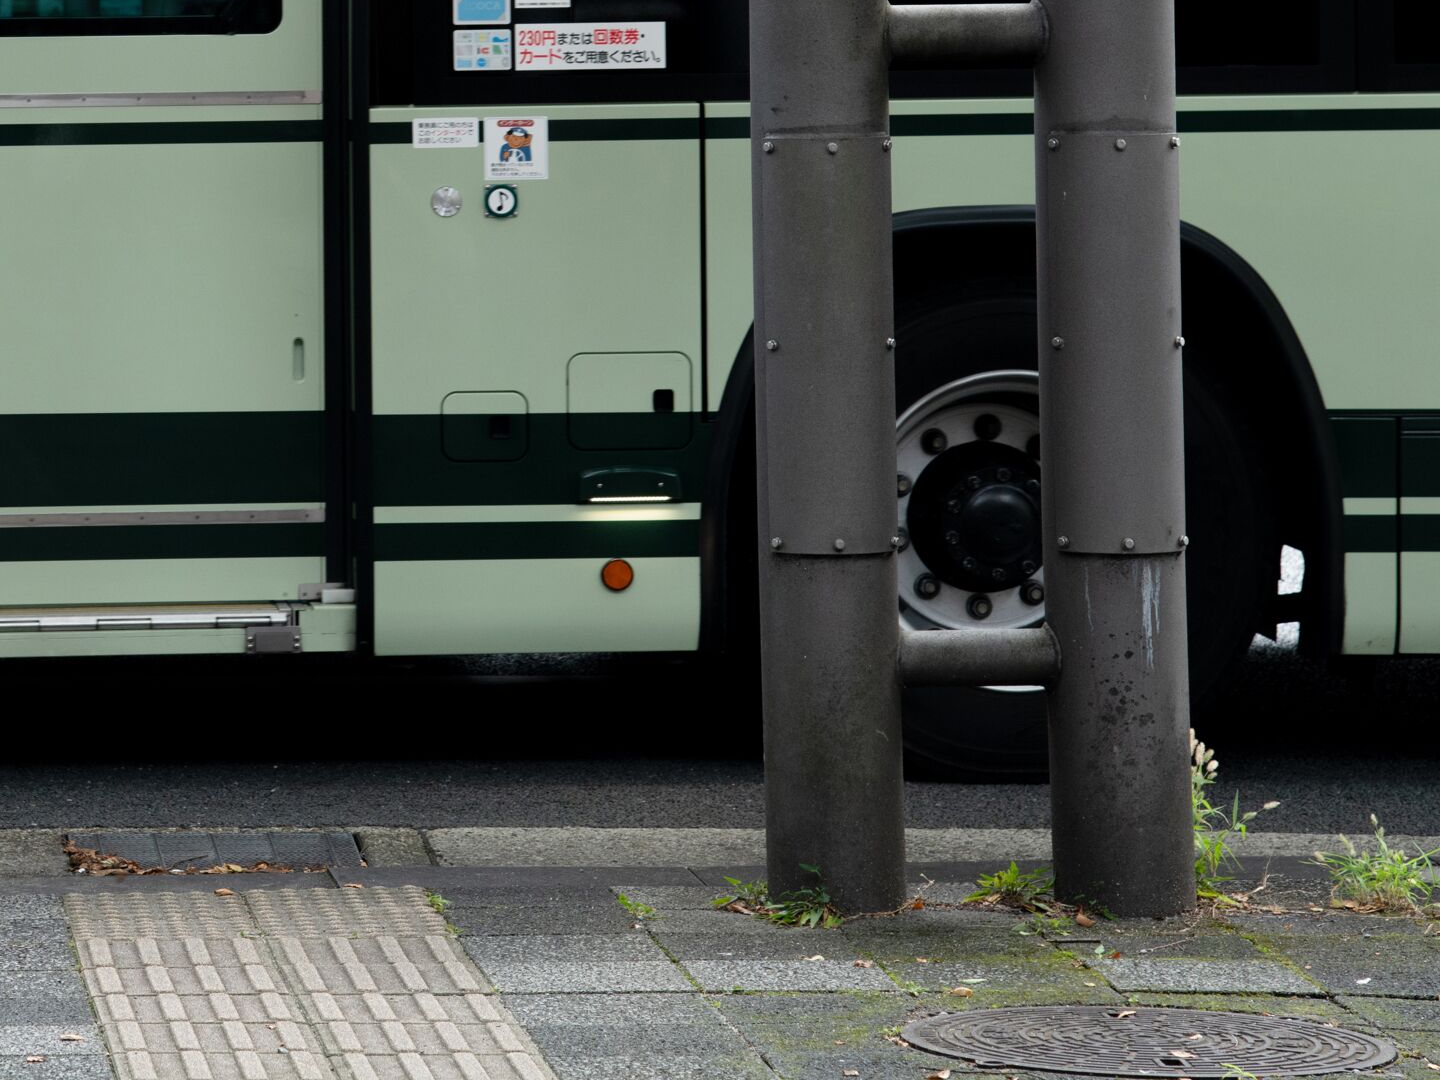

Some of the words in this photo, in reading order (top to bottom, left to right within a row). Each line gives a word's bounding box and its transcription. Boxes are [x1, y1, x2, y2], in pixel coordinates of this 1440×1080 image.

[518, 47, 663, 65] カードをご用意ください。
